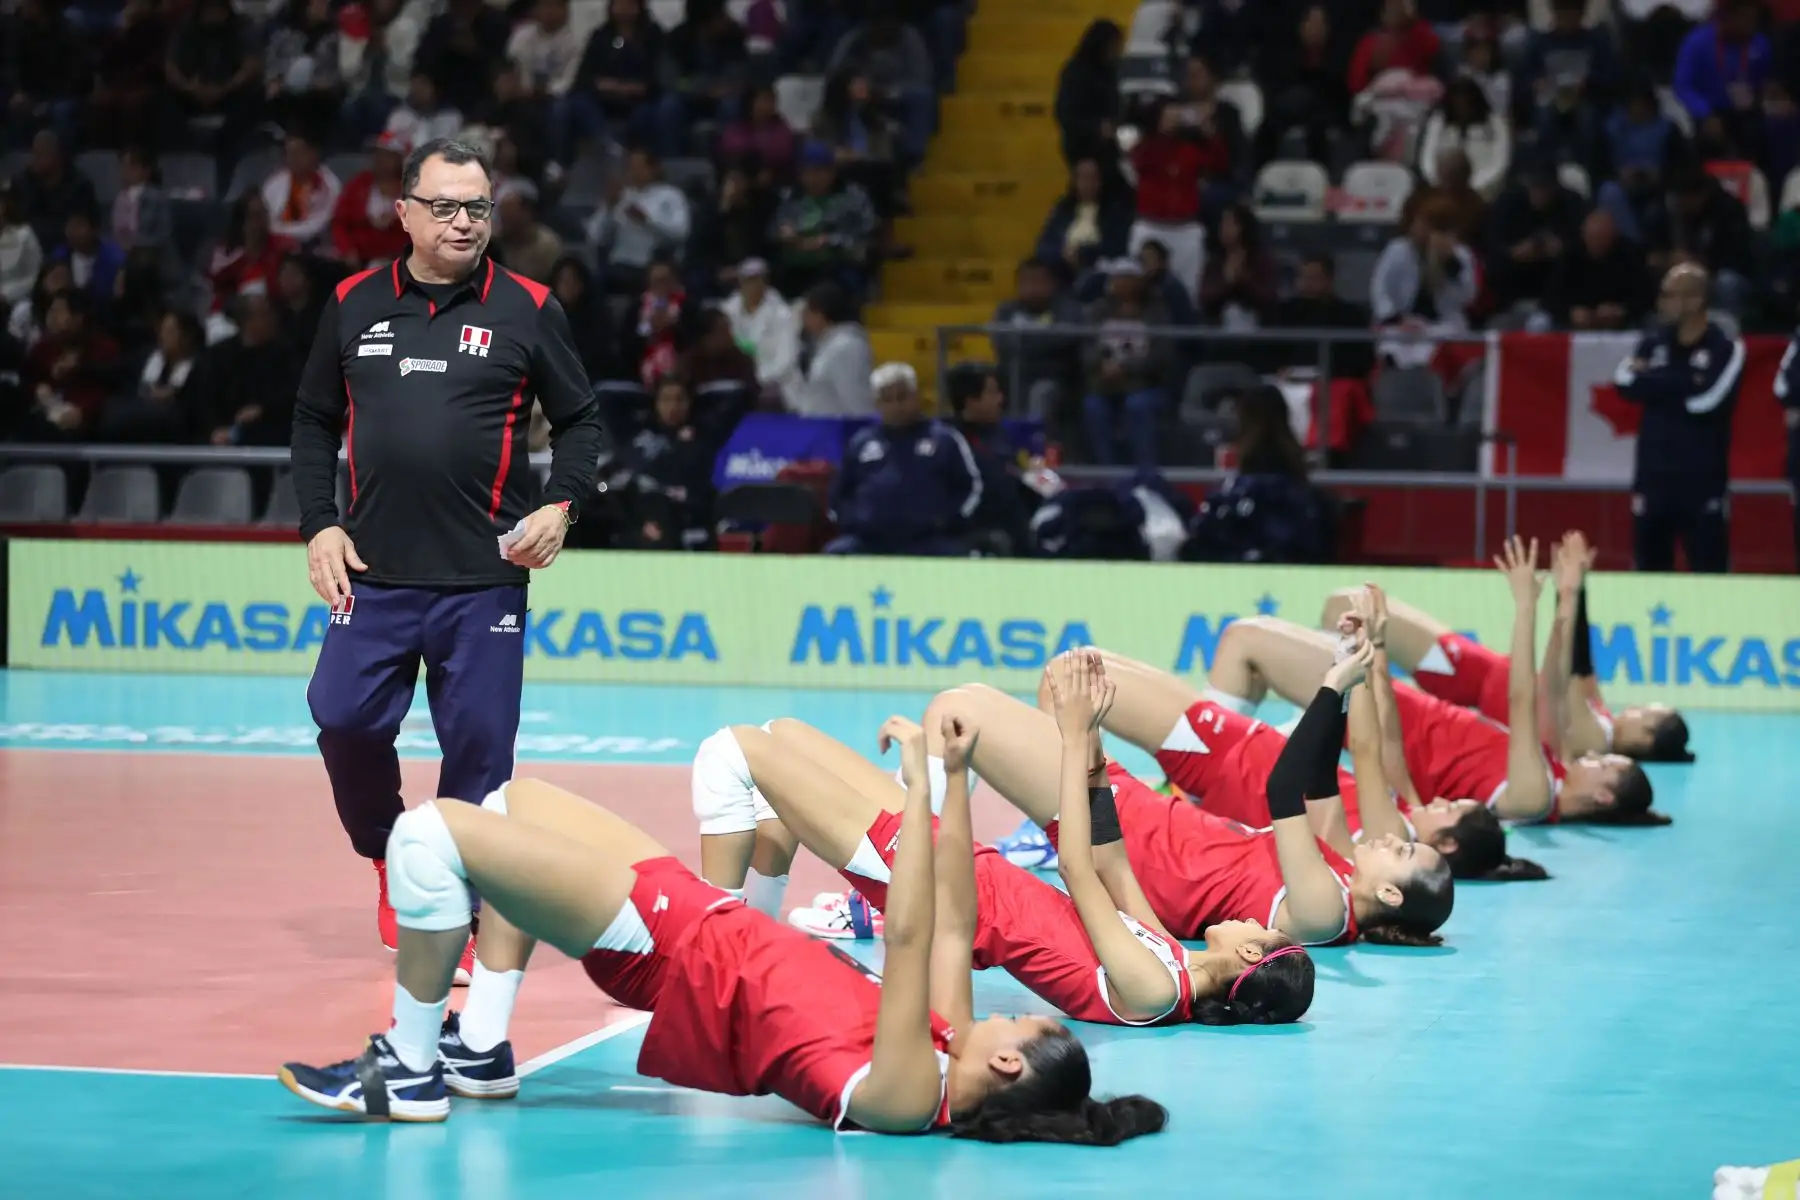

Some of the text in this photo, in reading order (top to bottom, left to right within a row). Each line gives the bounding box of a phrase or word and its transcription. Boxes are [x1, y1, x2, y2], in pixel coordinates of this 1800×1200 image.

[458, 343, 489, 358] PER
[410, 359, 447, 371] SPORADE
[40, 567, 334, 653] MIKASA
[330, 613, 351, 625] PER
[522, 609, 720, 663] KASA
